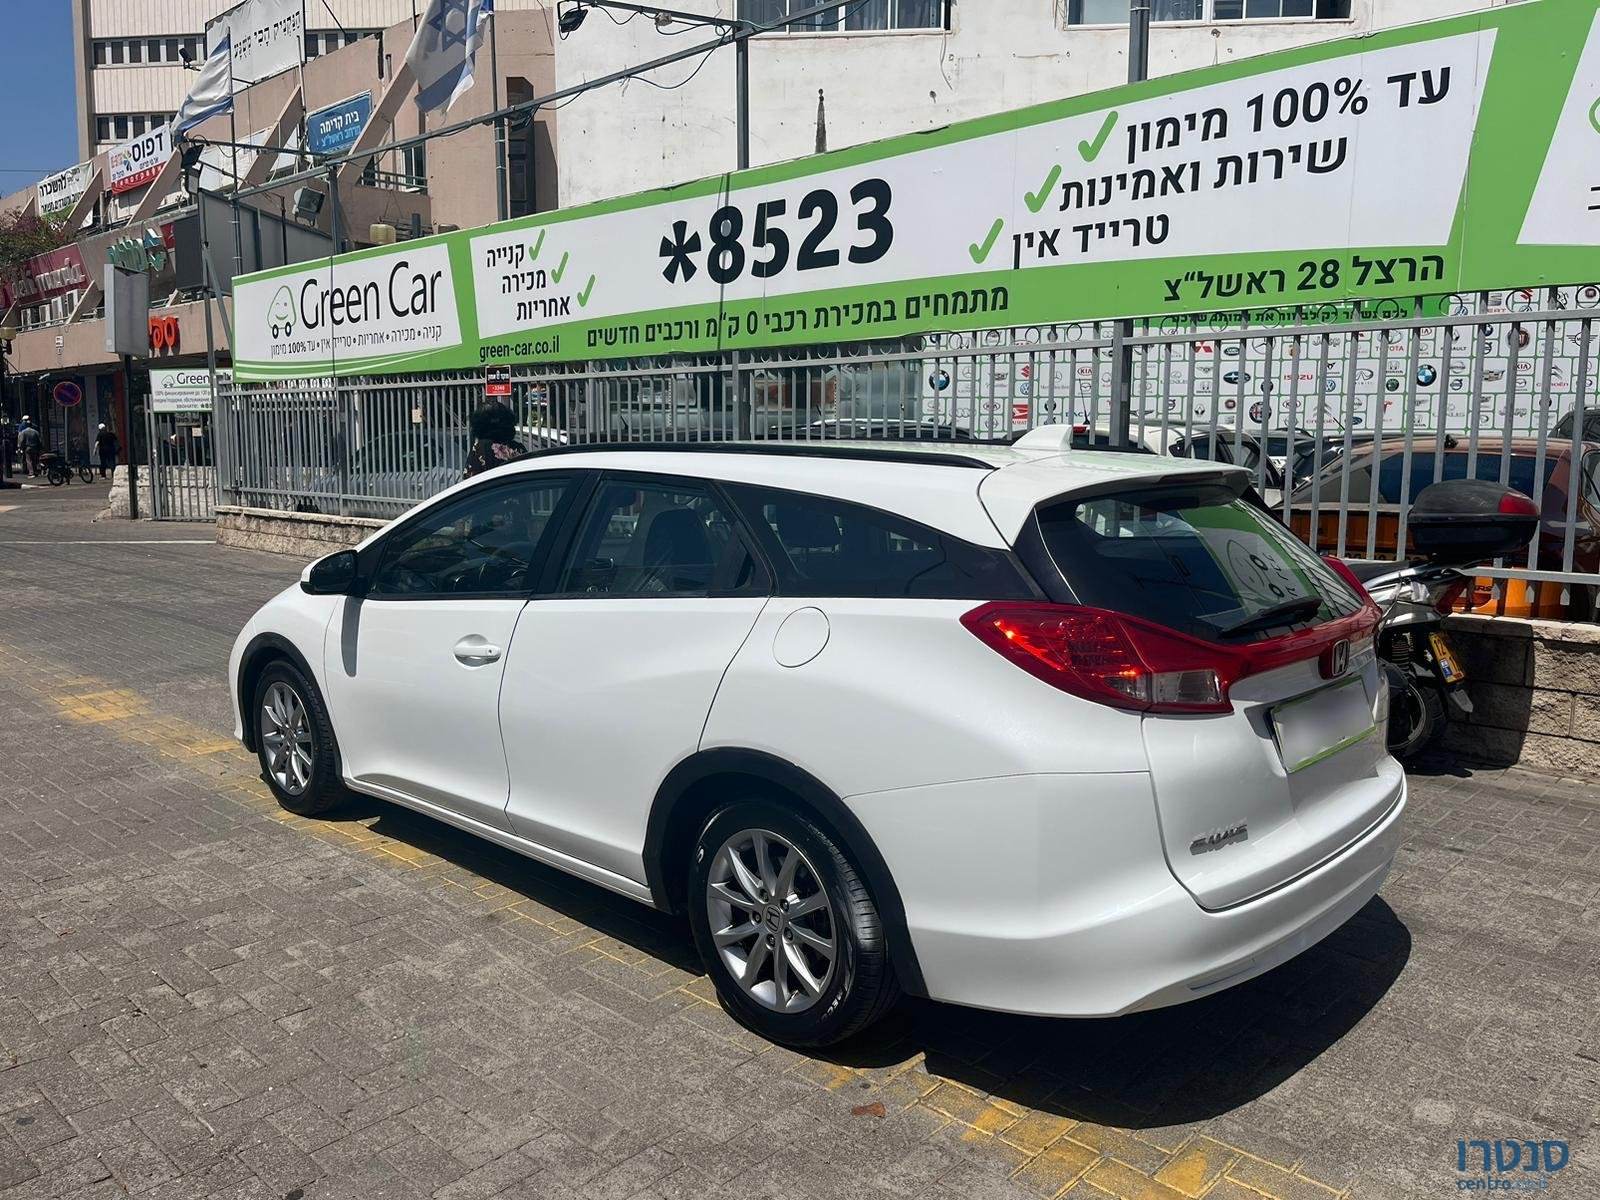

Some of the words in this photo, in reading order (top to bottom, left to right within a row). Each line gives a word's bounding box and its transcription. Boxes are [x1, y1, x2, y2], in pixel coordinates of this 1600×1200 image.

[1387, 66, 1451, 107] עד
[1246, 77, 1368, 133] 100%
[346, 111, 359, 128] בית
[132, 133, 163, 162] דפוס
[1127, 108, 1228, 164] מימון
[1214, 137, 1347, 189] שירות
[1060, 162, 1200, 212] ואמינות
[1073, 213, 1170, 250] טרייד
[487, 244, 524, 269] קנייה
[1013, 228, 1060, 269] אין
[502, 270, 546, 294] מכירה
[1298, 259, 1340, 289] 28
[1352, 254, 1444, 286] הרצל
[300, 278, 380, 330] Green
[388, 260, 442, 318] Car
[906, 286, 1009, 320] מתמחים
[517, 296, 570, 321] אחריות
[814, 299, 896, 329] במכירת
[422, 326, 442, 342] קניה
[588, 322, 639, 347] חדשים
[645, 320, 699, 342] ורכבים
[747, 312, 758, 335] 0
[765, 310, 806, 334] רכבי
[288, 341, 306, 354] 100%
[307, 340, 315, 350] עד
[320, 338, 331, 352] אין
[358, 331, 385, 346] אחריות
[391, 328, 416, 344] מכירה
[479, 336, 560, 362] green-car.co.il
[176, 372, 209, 384] Green
